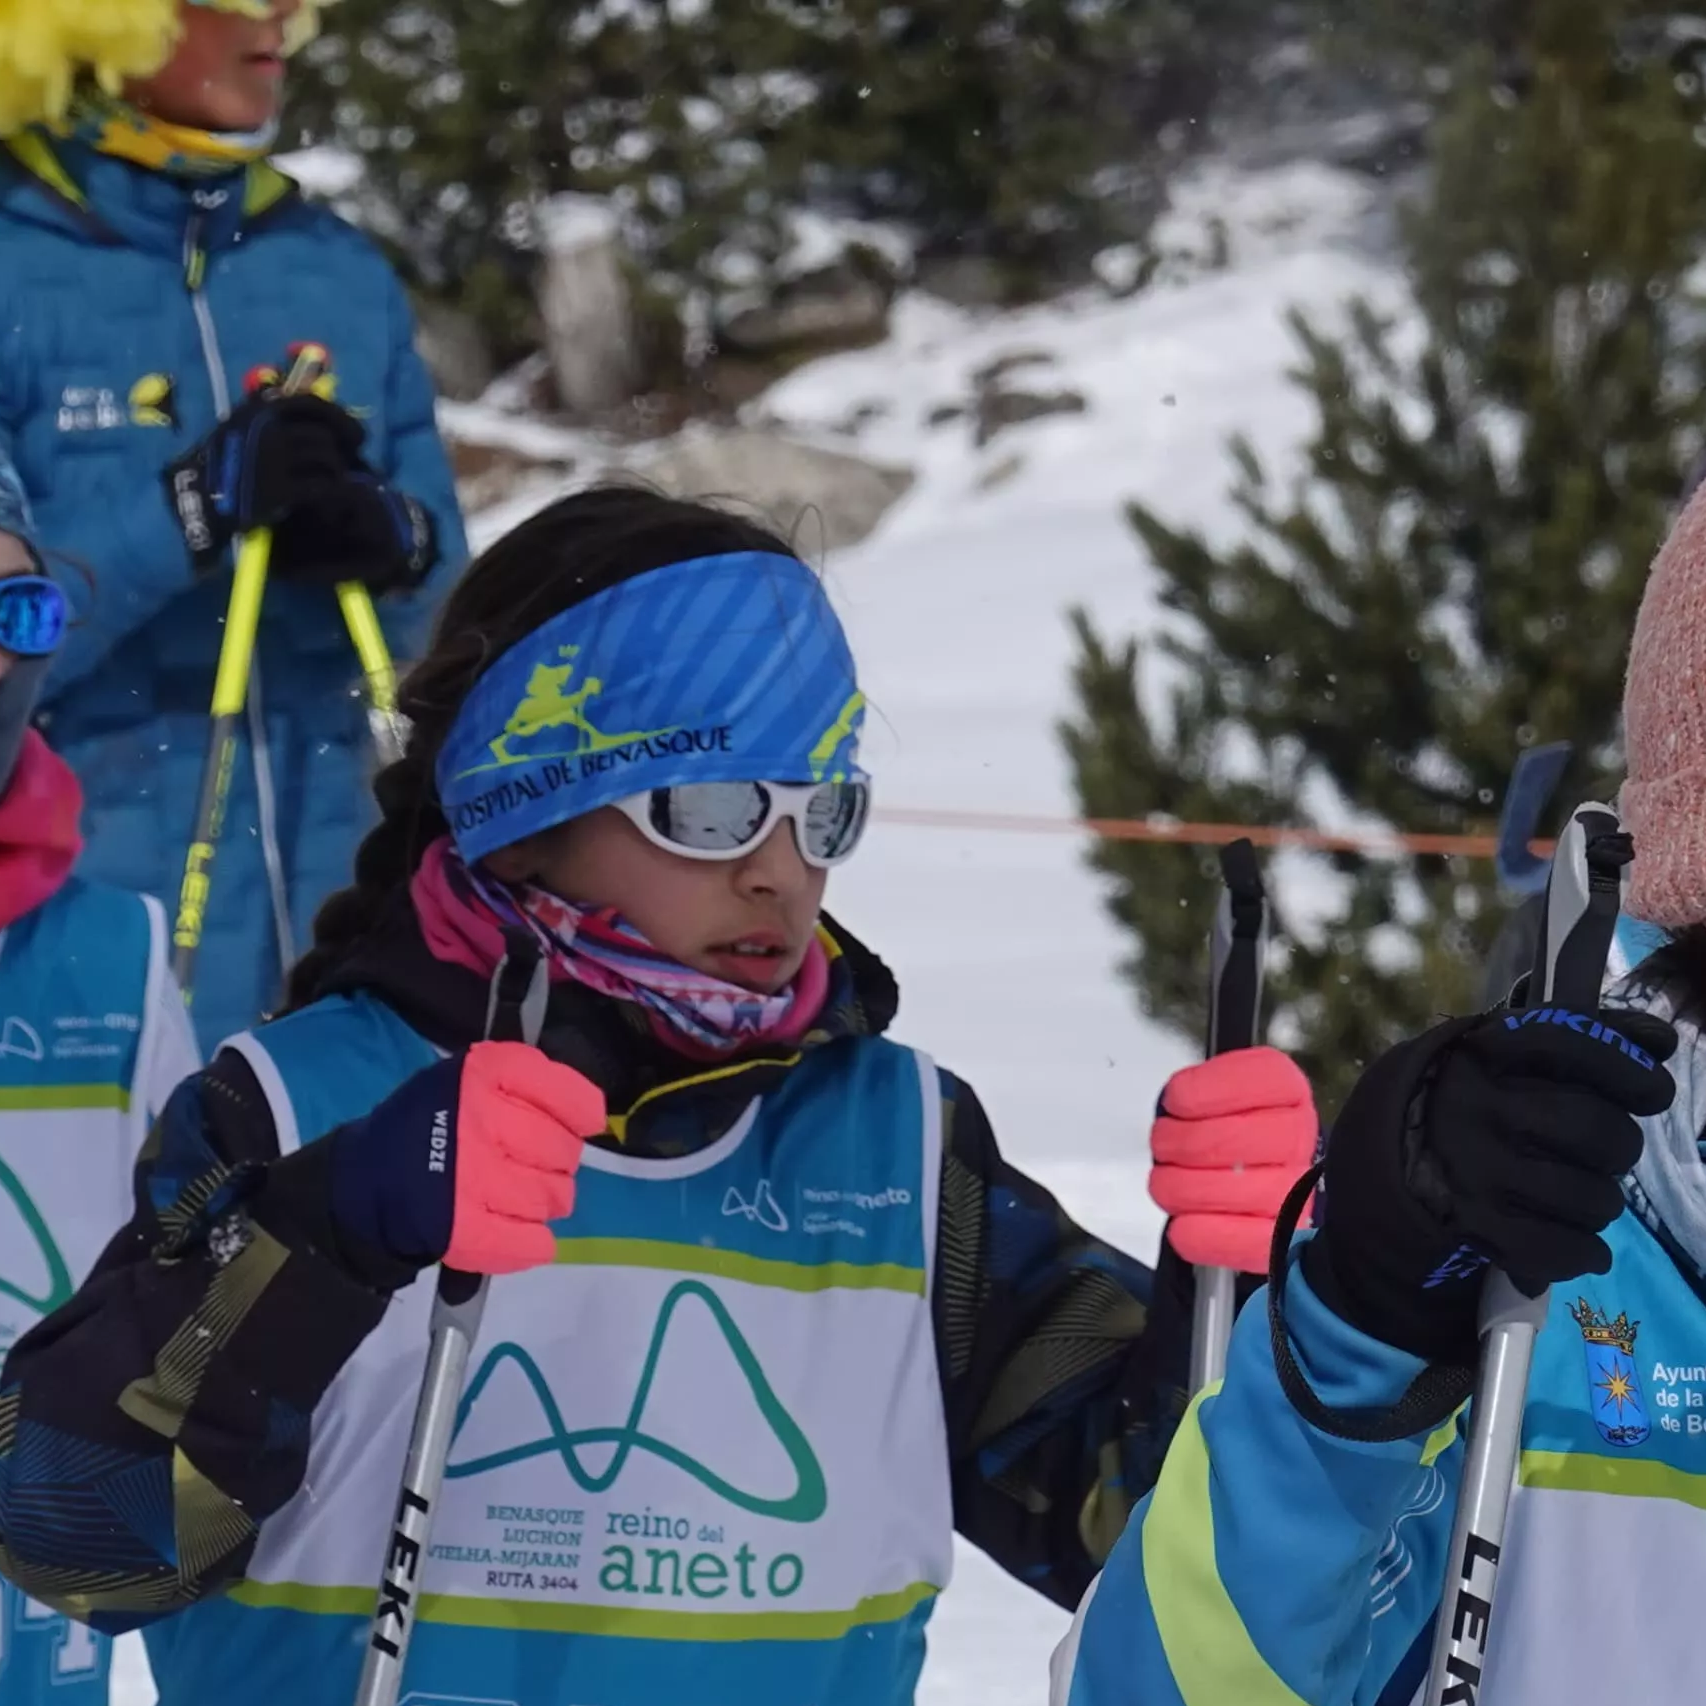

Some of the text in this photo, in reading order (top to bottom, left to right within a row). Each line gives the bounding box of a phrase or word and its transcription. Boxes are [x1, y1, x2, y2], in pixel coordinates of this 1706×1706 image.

[542, 759, 577, 792] DE
[580, 725, 733, 779] BENASQUE
[428, 1110, 449, 1173] WEDZE
[1656, 1389, 1679, 1408] de
[1685, 1388, 1704, 1408] la
[1660, 1413, 1681, 1433] de
[485, 1504, 585, 1526] BENASQUE
[605, 1507, 725, 1543] reino del
[503, 1528, 583, 1547] LUCHON
[371, 1487, 429, 1660] LEKI
[486, 1570, 579, 1592] RUTA 3404
[598, 1543, 804, 1599] aneto
